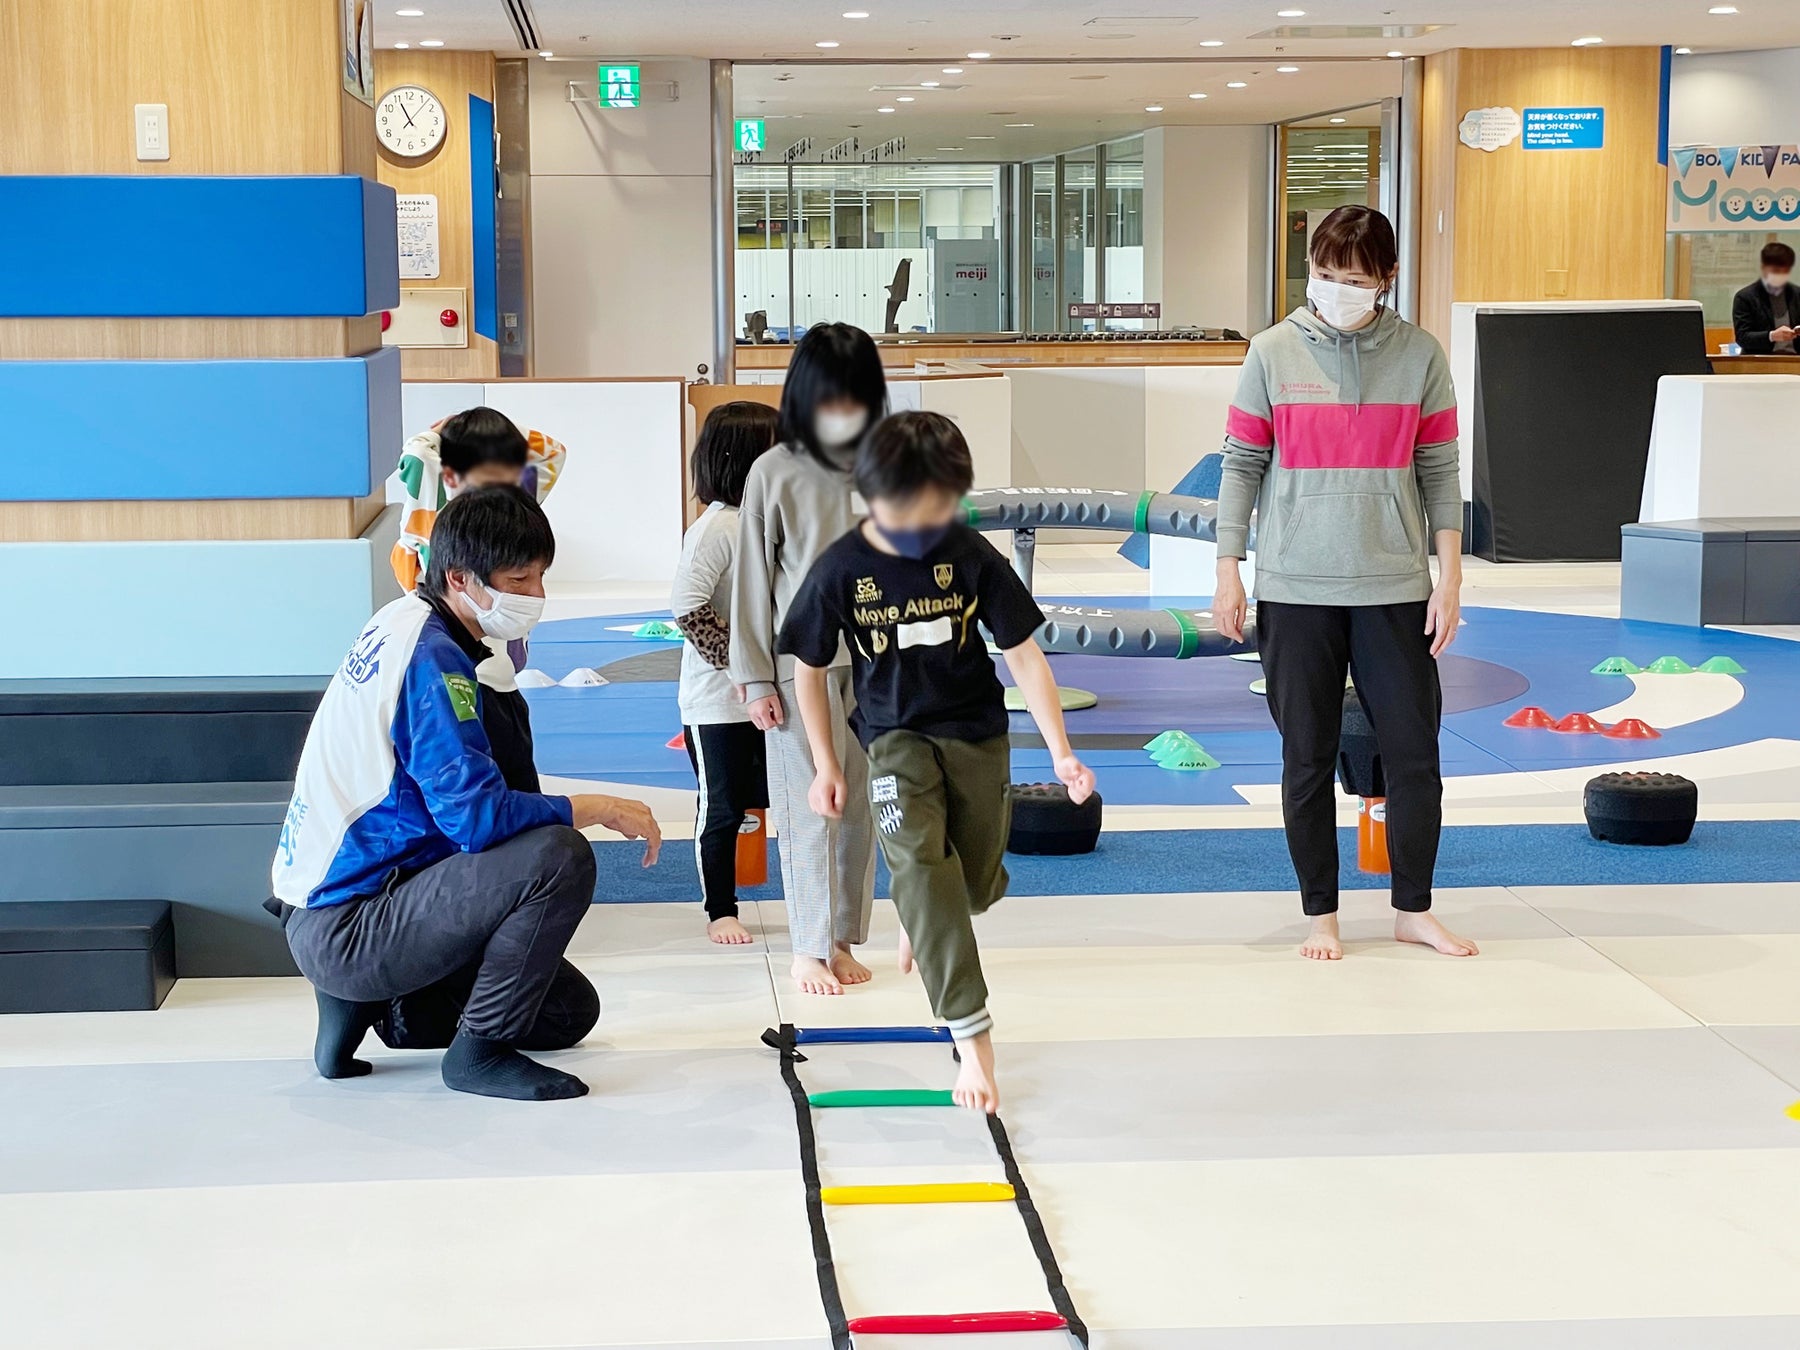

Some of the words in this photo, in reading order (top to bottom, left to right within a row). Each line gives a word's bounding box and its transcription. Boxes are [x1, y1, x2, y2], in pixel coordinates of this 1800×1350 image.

[394, 95, 401, 103] 11
[405, 91, 414, 100] 12
[385, 104, 394, 113] 10
[955, 268, 987, 280] meiji
[854, 605, 900, 627] Move
[904, 592, 964, 619] Attack
